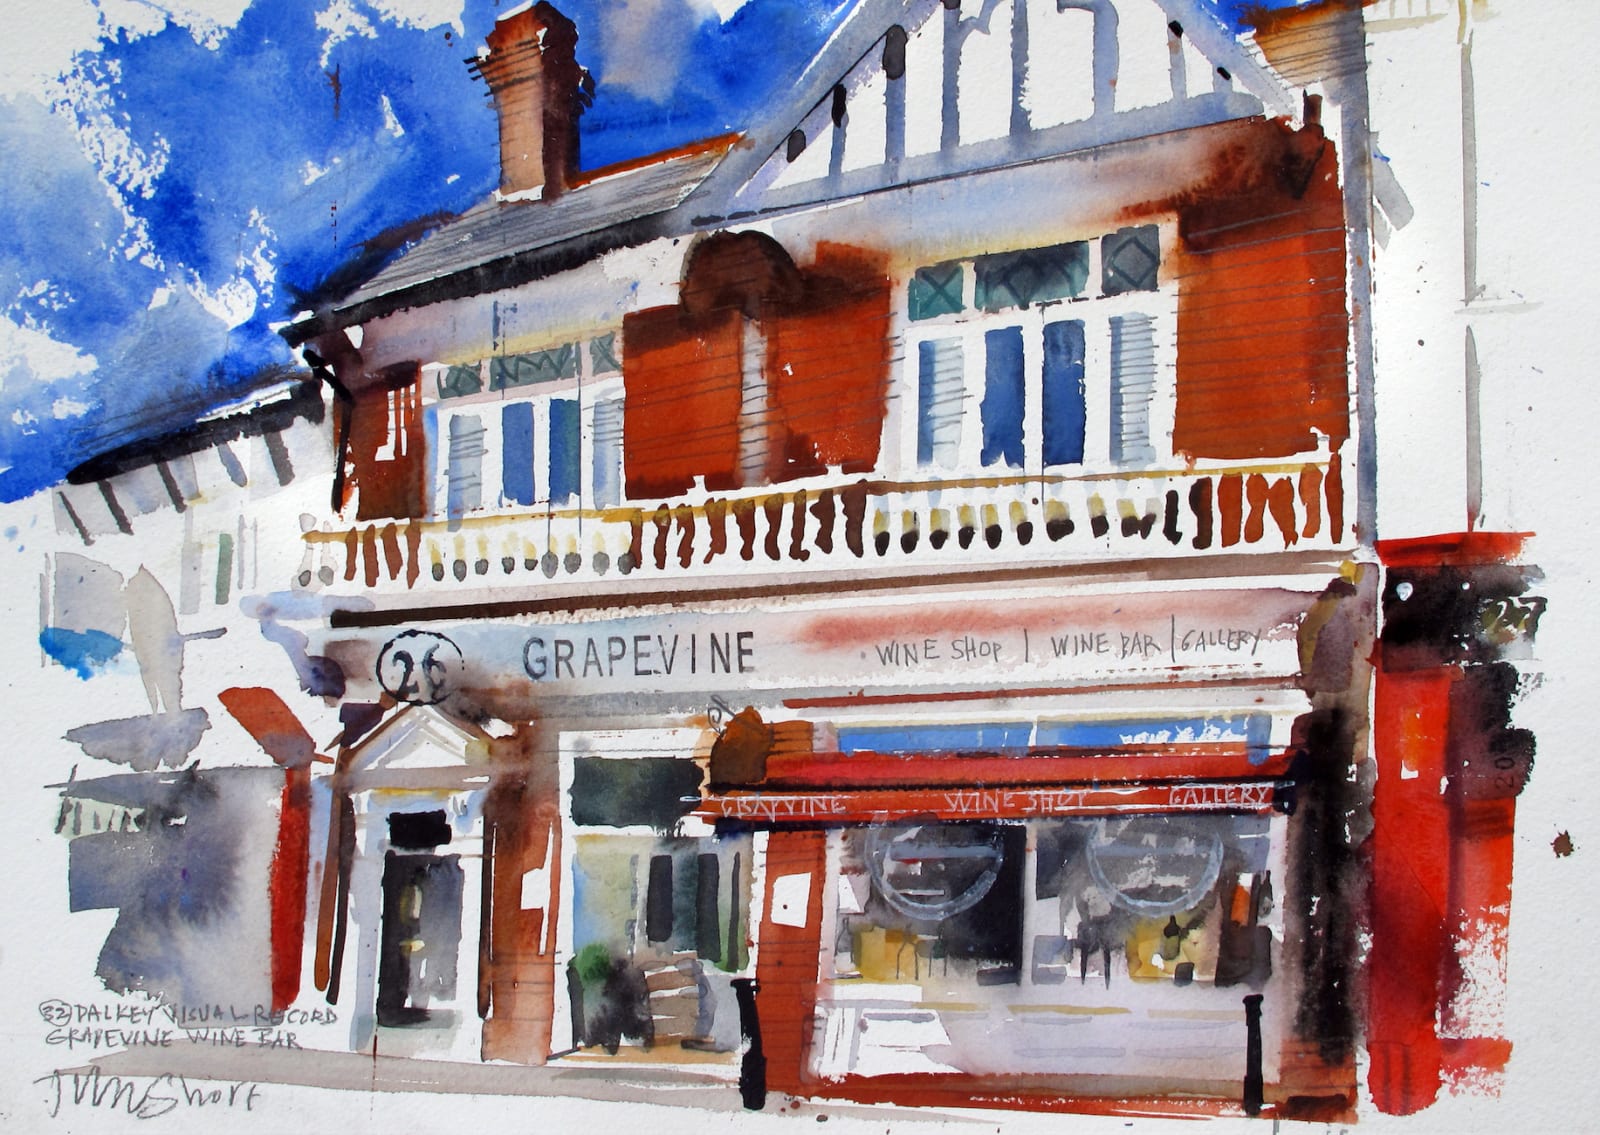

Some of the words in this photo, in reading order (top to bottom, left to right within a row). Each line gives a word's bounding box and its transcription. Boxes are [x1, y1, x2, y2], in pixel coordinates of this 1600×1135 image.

[875, 638, 940, 667] WINE
[951, 636, 1003, 662] SHOP
[1050, 632, 1110, 656] WINE
[1120, 631, 1161, 658] BAR
[1180, 628, 1262, 656] GALLERY
[523, 631, 755, 681] GRAPEVINE
[944, 790, 1015, 814] WINE
[74, 1002, 156, 1025] DALKEY
[254, 1002, 339, 1026] RECORD
[45, 1027, 174, 1050] GRAPEVINE
[187, 1027, 247, 1047] WINE
[253, 1028, 305, 1050] BAR
